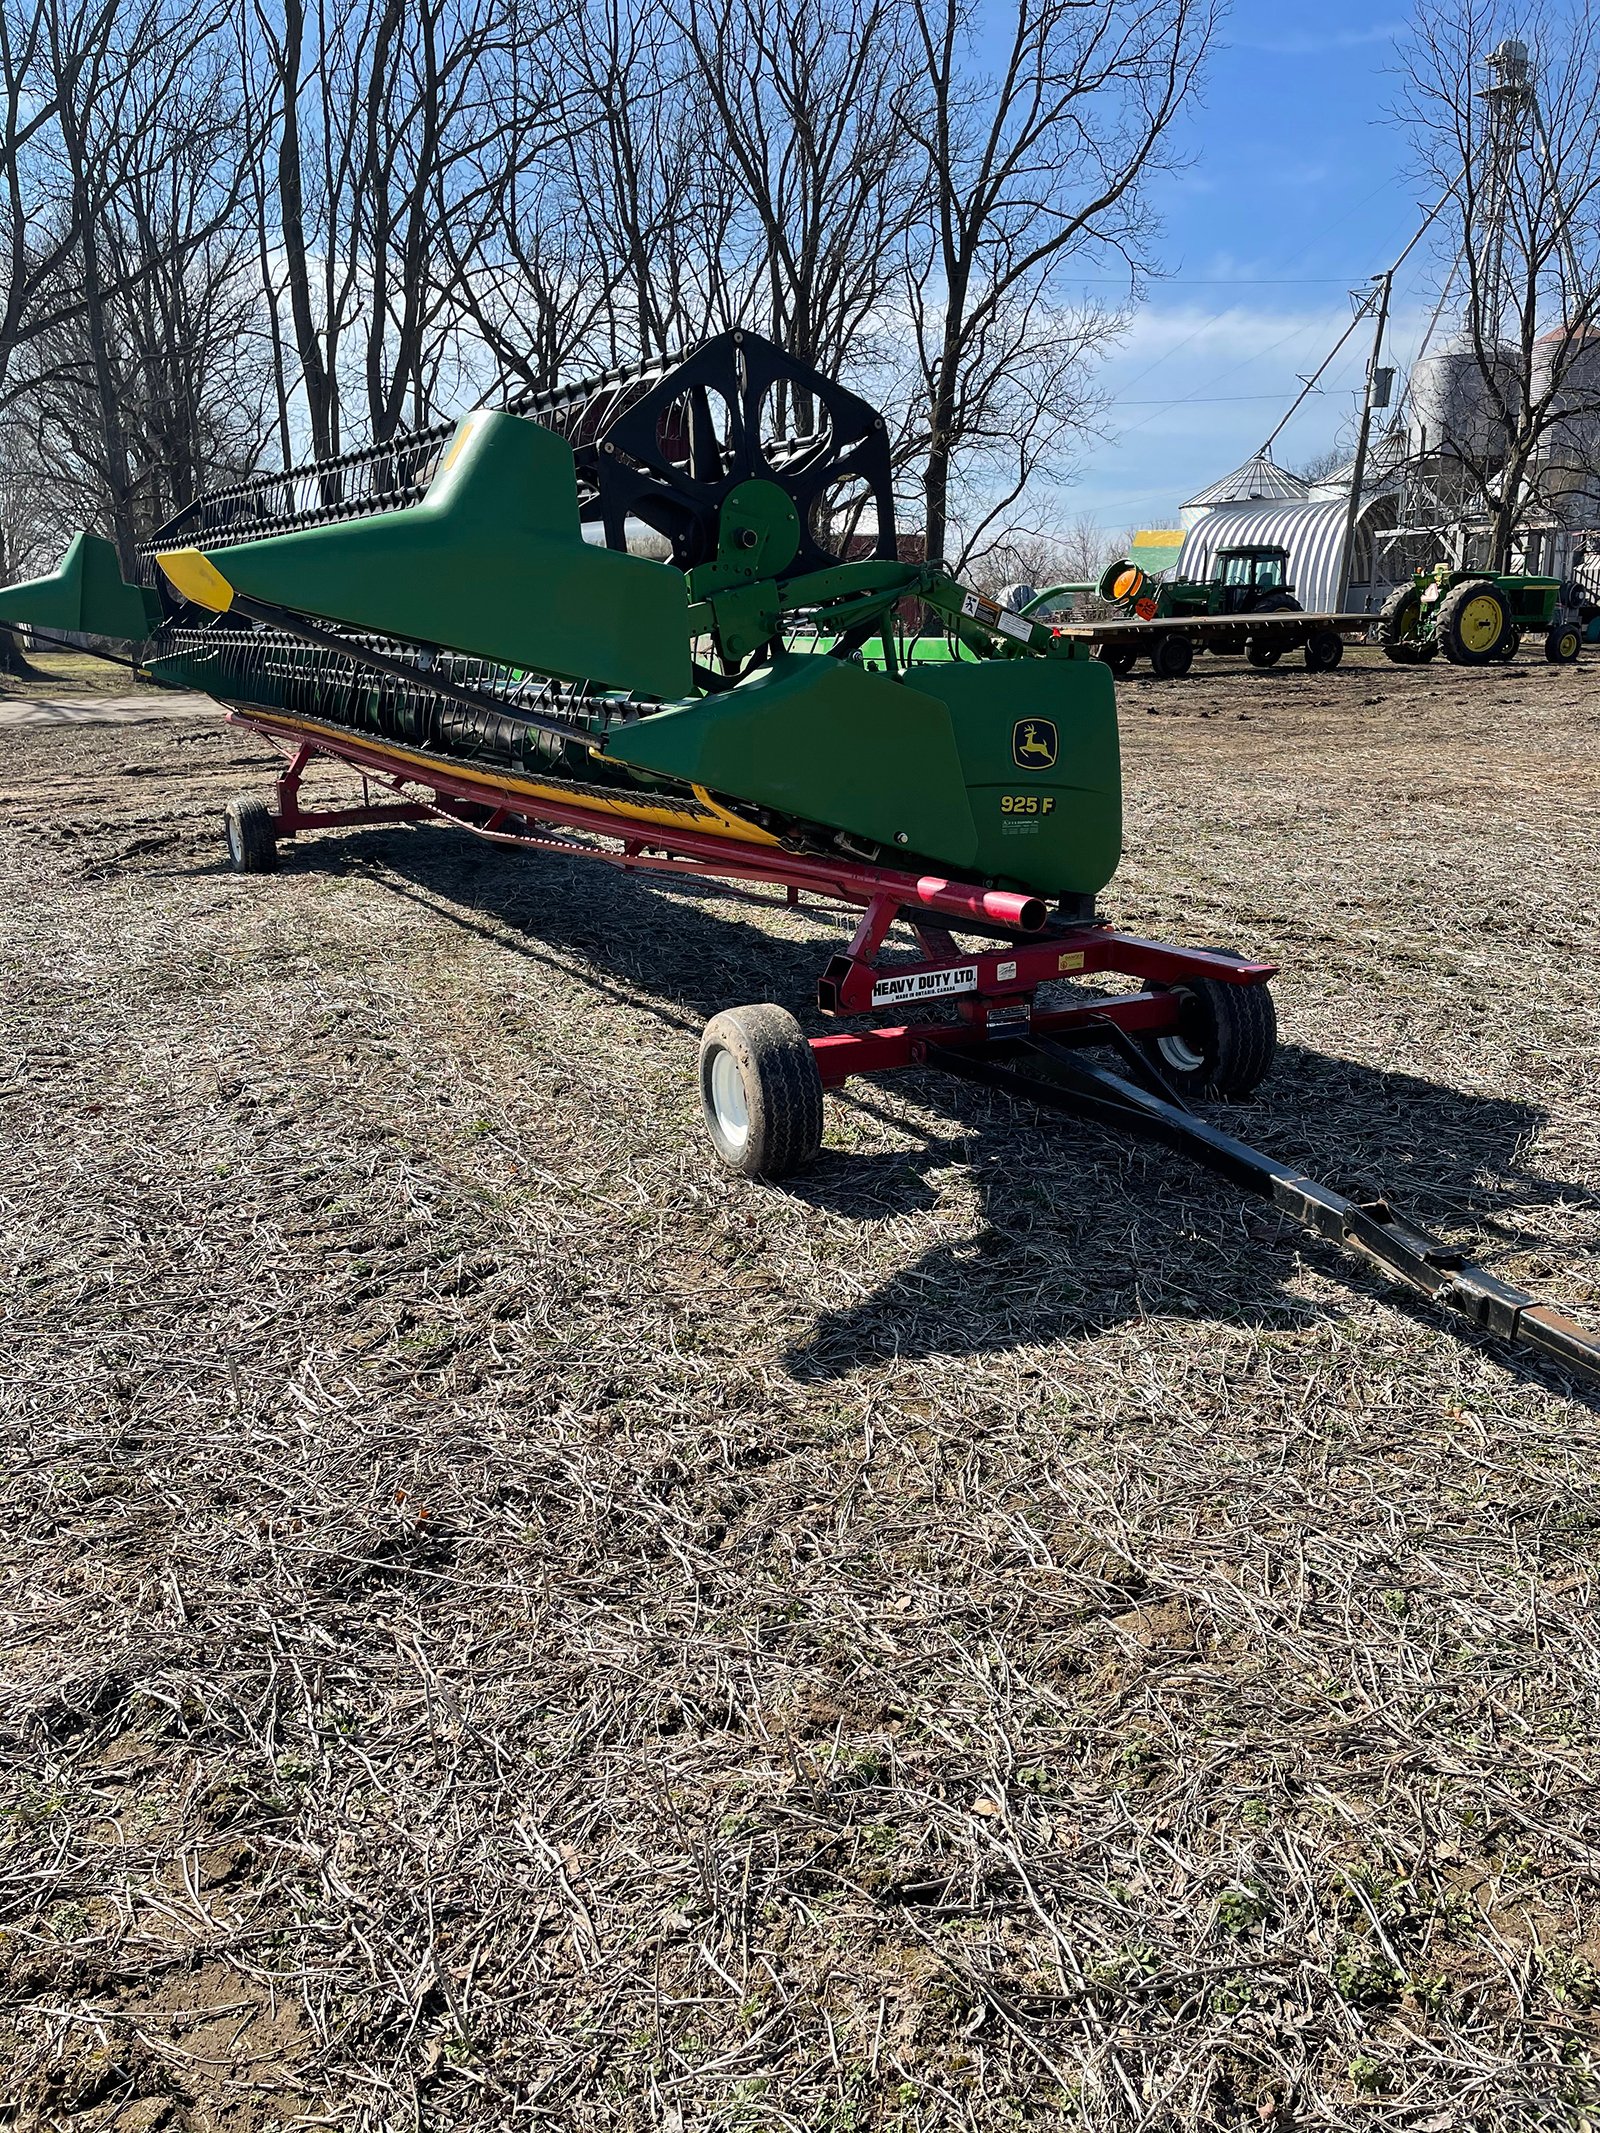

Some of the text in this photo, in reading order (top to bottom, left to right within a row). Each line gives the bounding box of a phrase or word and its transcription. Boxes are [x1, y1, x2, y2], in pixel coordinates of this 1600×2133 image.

[1001, 796, 1054, 814] 925 F
[873, 978, 915, 997] HEAVY
[918, 972, 951, 990] DUTY
[895, 993, 908, 1001] MADE
[936, 986, 956, 994] CANADA
